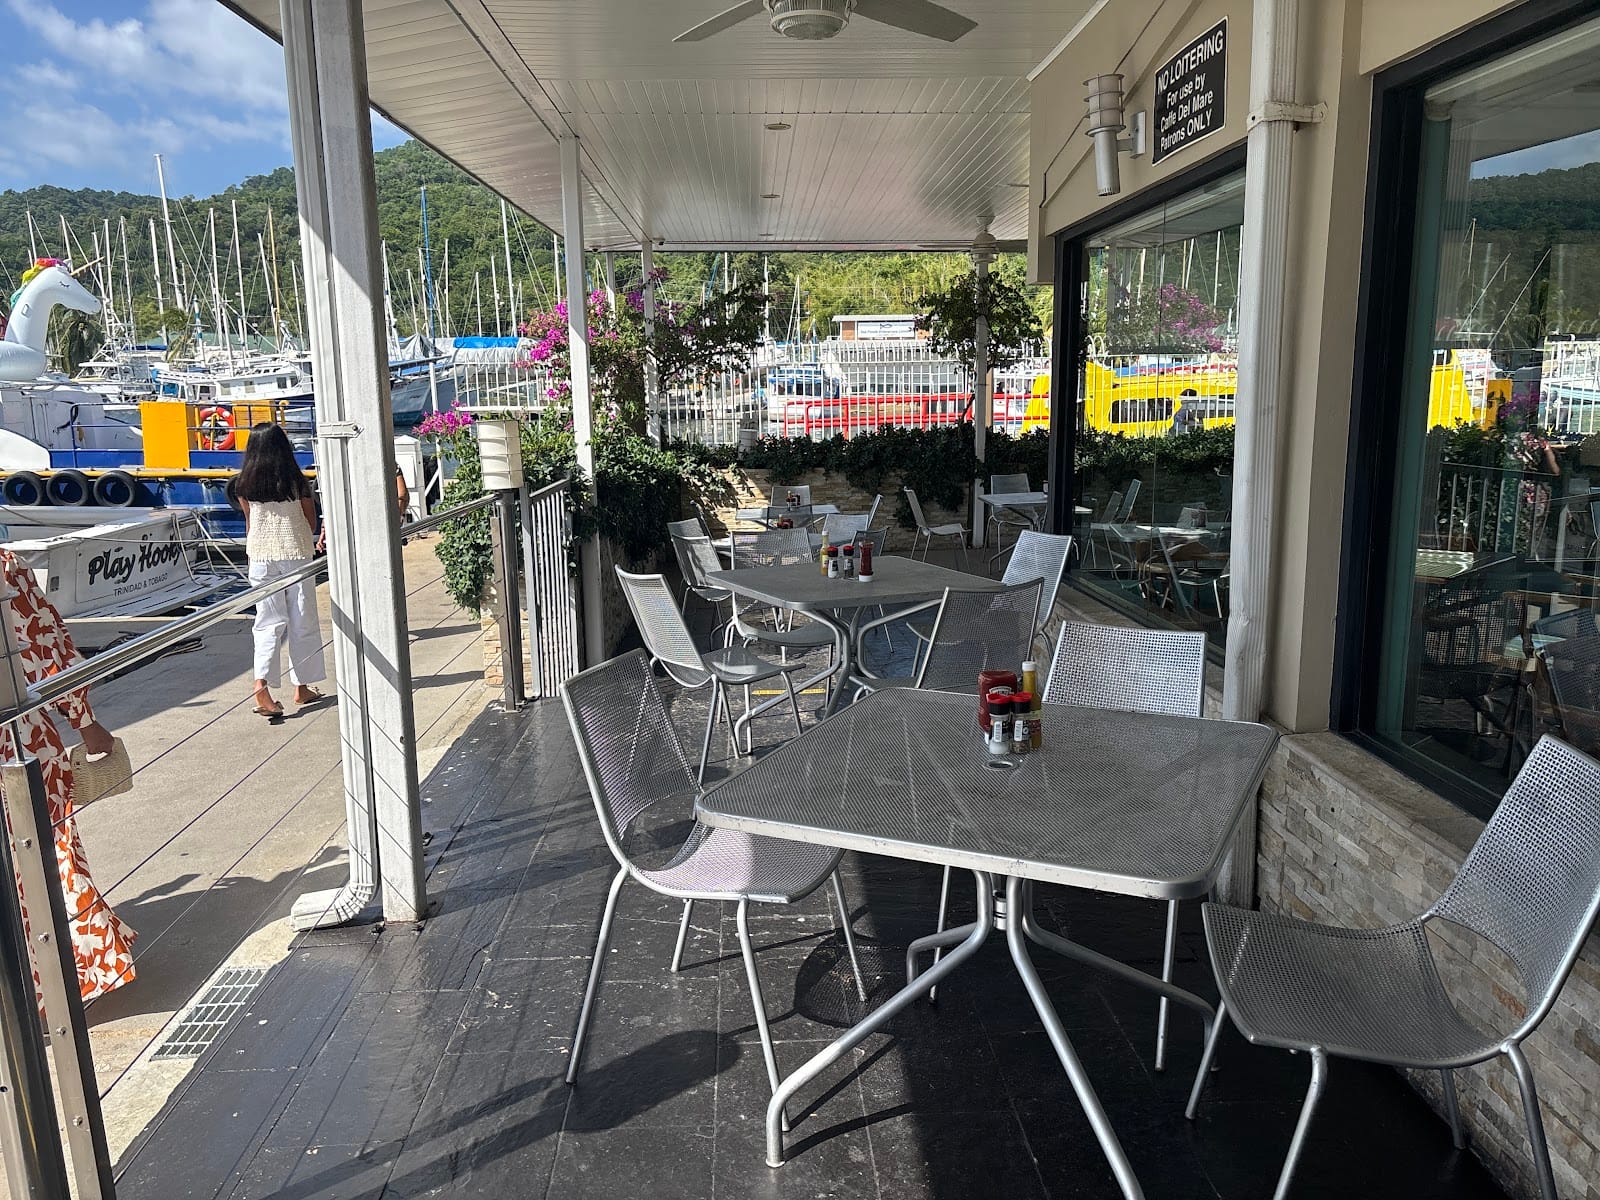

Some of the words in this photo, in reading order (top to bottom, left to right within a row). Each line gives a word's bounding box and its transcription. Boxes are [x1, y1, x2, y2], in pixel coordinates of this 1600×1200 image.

[1158, 70, 1169, 95] NO
[1170, 30, 1224, 84] LOITERING
[1166, 90, 1178, 109] For
[1179, 81, 1193, 100] use
[1195, 72, 1206, 92] by
[1160, 110, 1176, 132] Caffe
[1178, 99, 1190, 121] Del
[1192, 90, 1213, 113] Mare
[1161, 127, 1185, 152] Patrons
[1187, 108, 1212, 136] ONLY
[88, 549, 135, 585] Play
[113, 582, 142, 597] TRINIDAD
